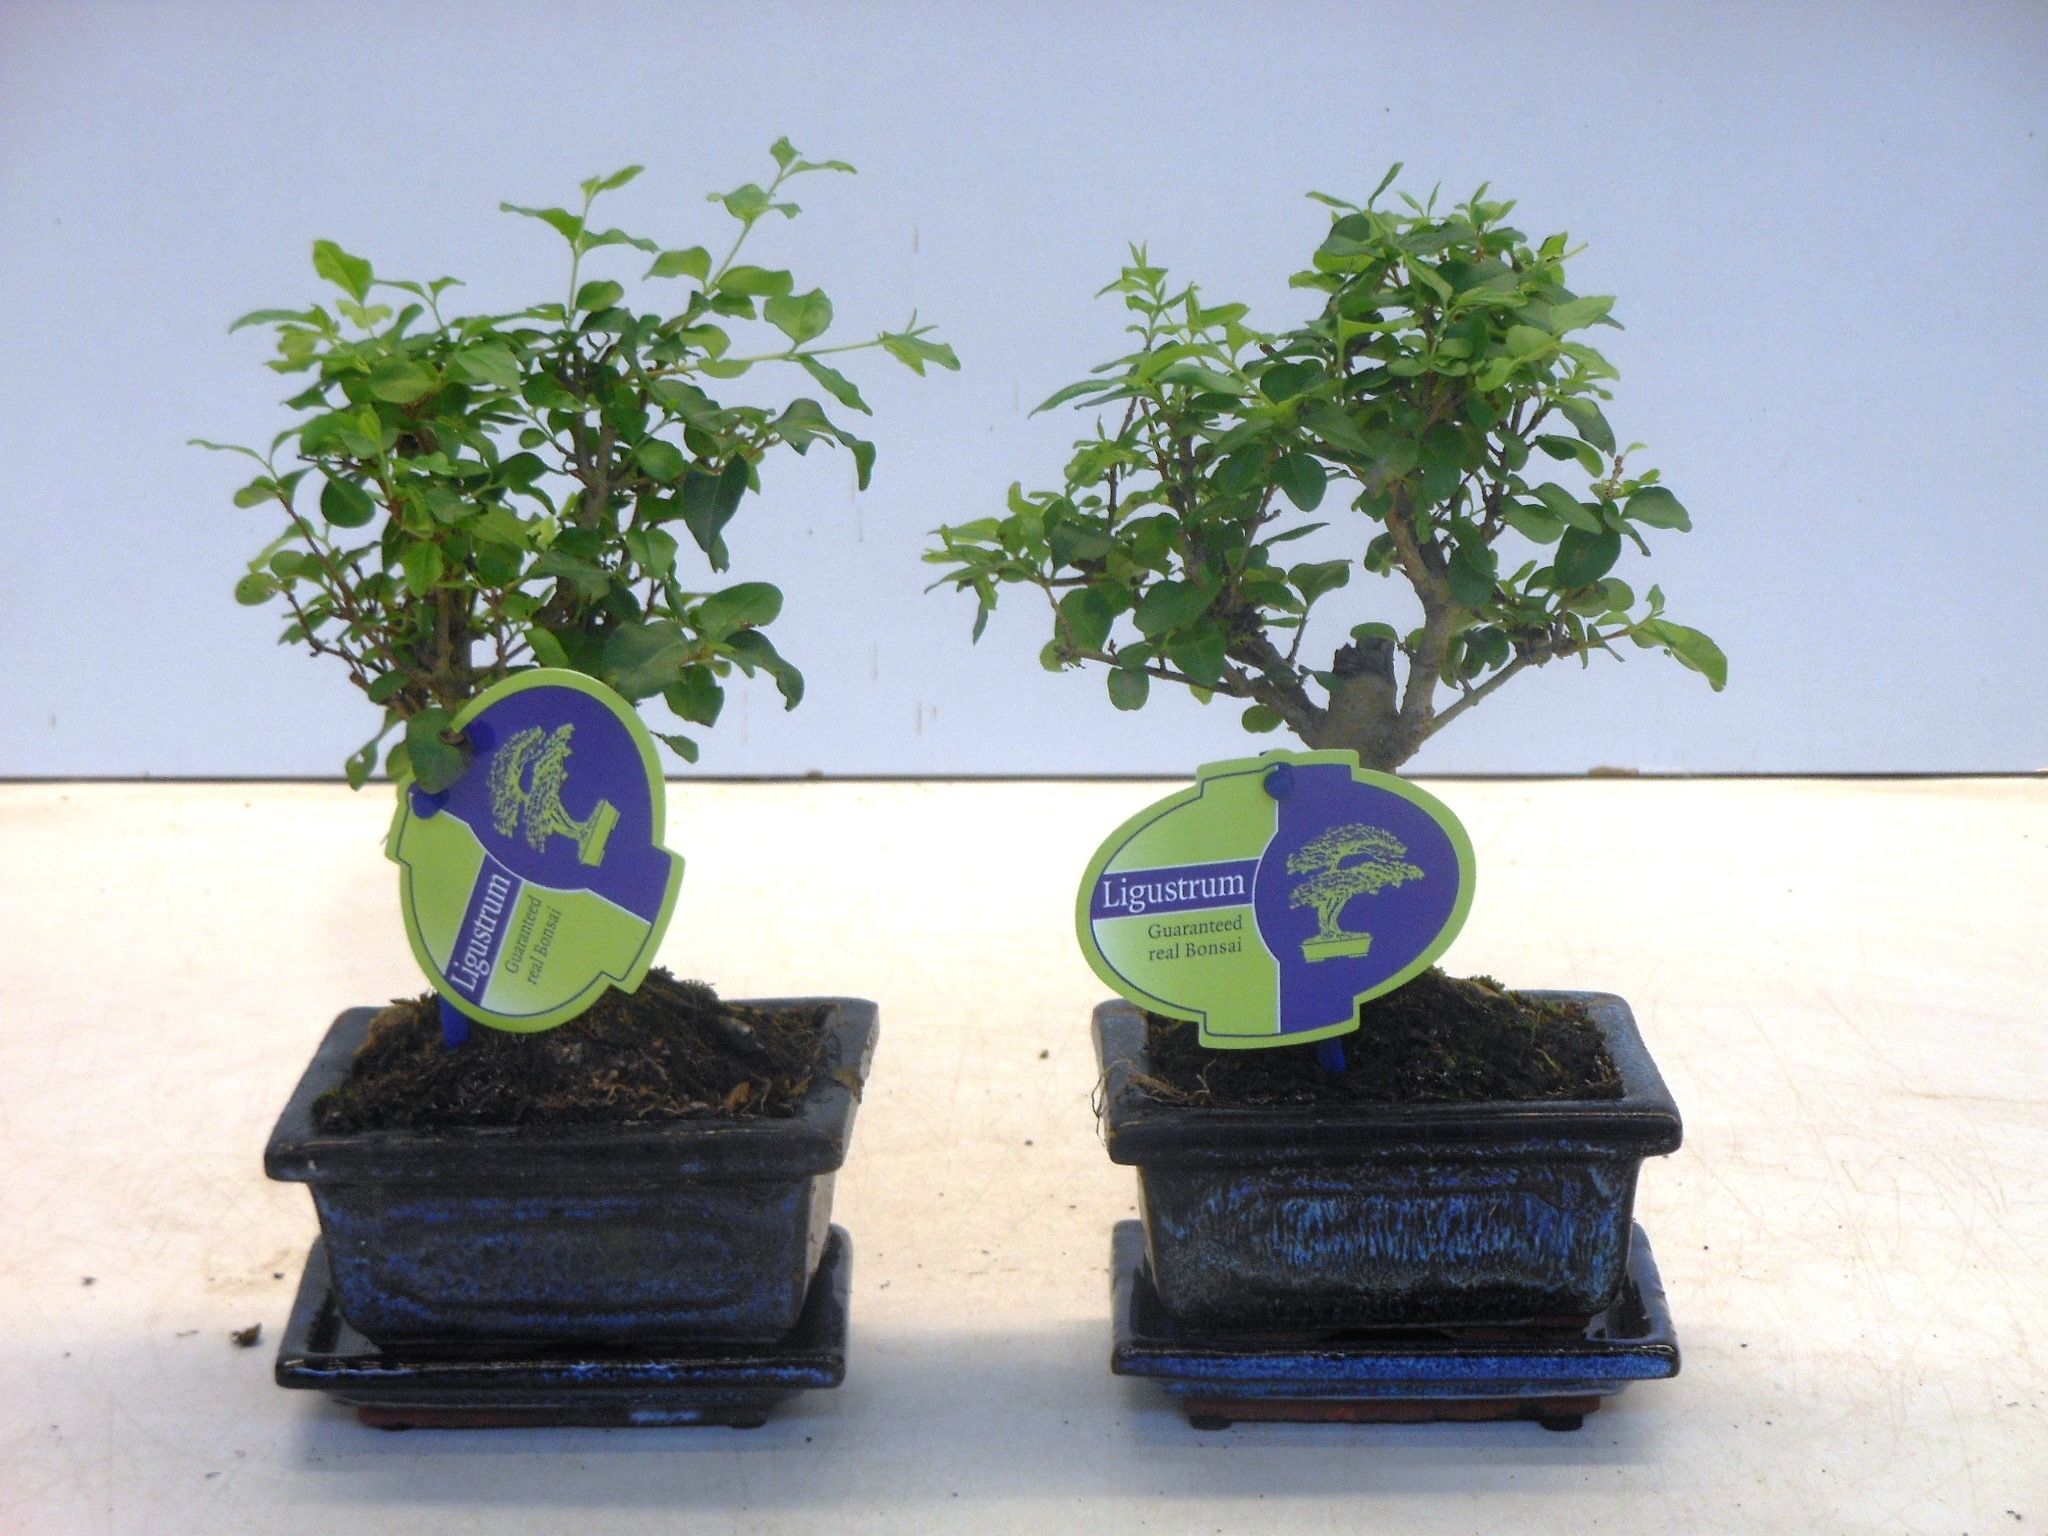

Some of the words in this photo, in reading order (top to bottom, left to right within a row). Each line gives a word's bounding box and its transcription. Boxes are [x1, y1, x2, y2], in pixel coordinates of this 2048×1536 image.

[1102, 874, 1245, 913] Ligustrum
[450, 874, 511, 992] Ligustrum
[504, 894, 542, 974] Guaranteed
[534, 906, 562, 957] Bonsai
[1147, 914, 1243, 939] Guaranteed
[1148, 943, 1179, 961] real
[1186, 937, 1242, 957] Bonsai
[527, 956, 544, 985] real
